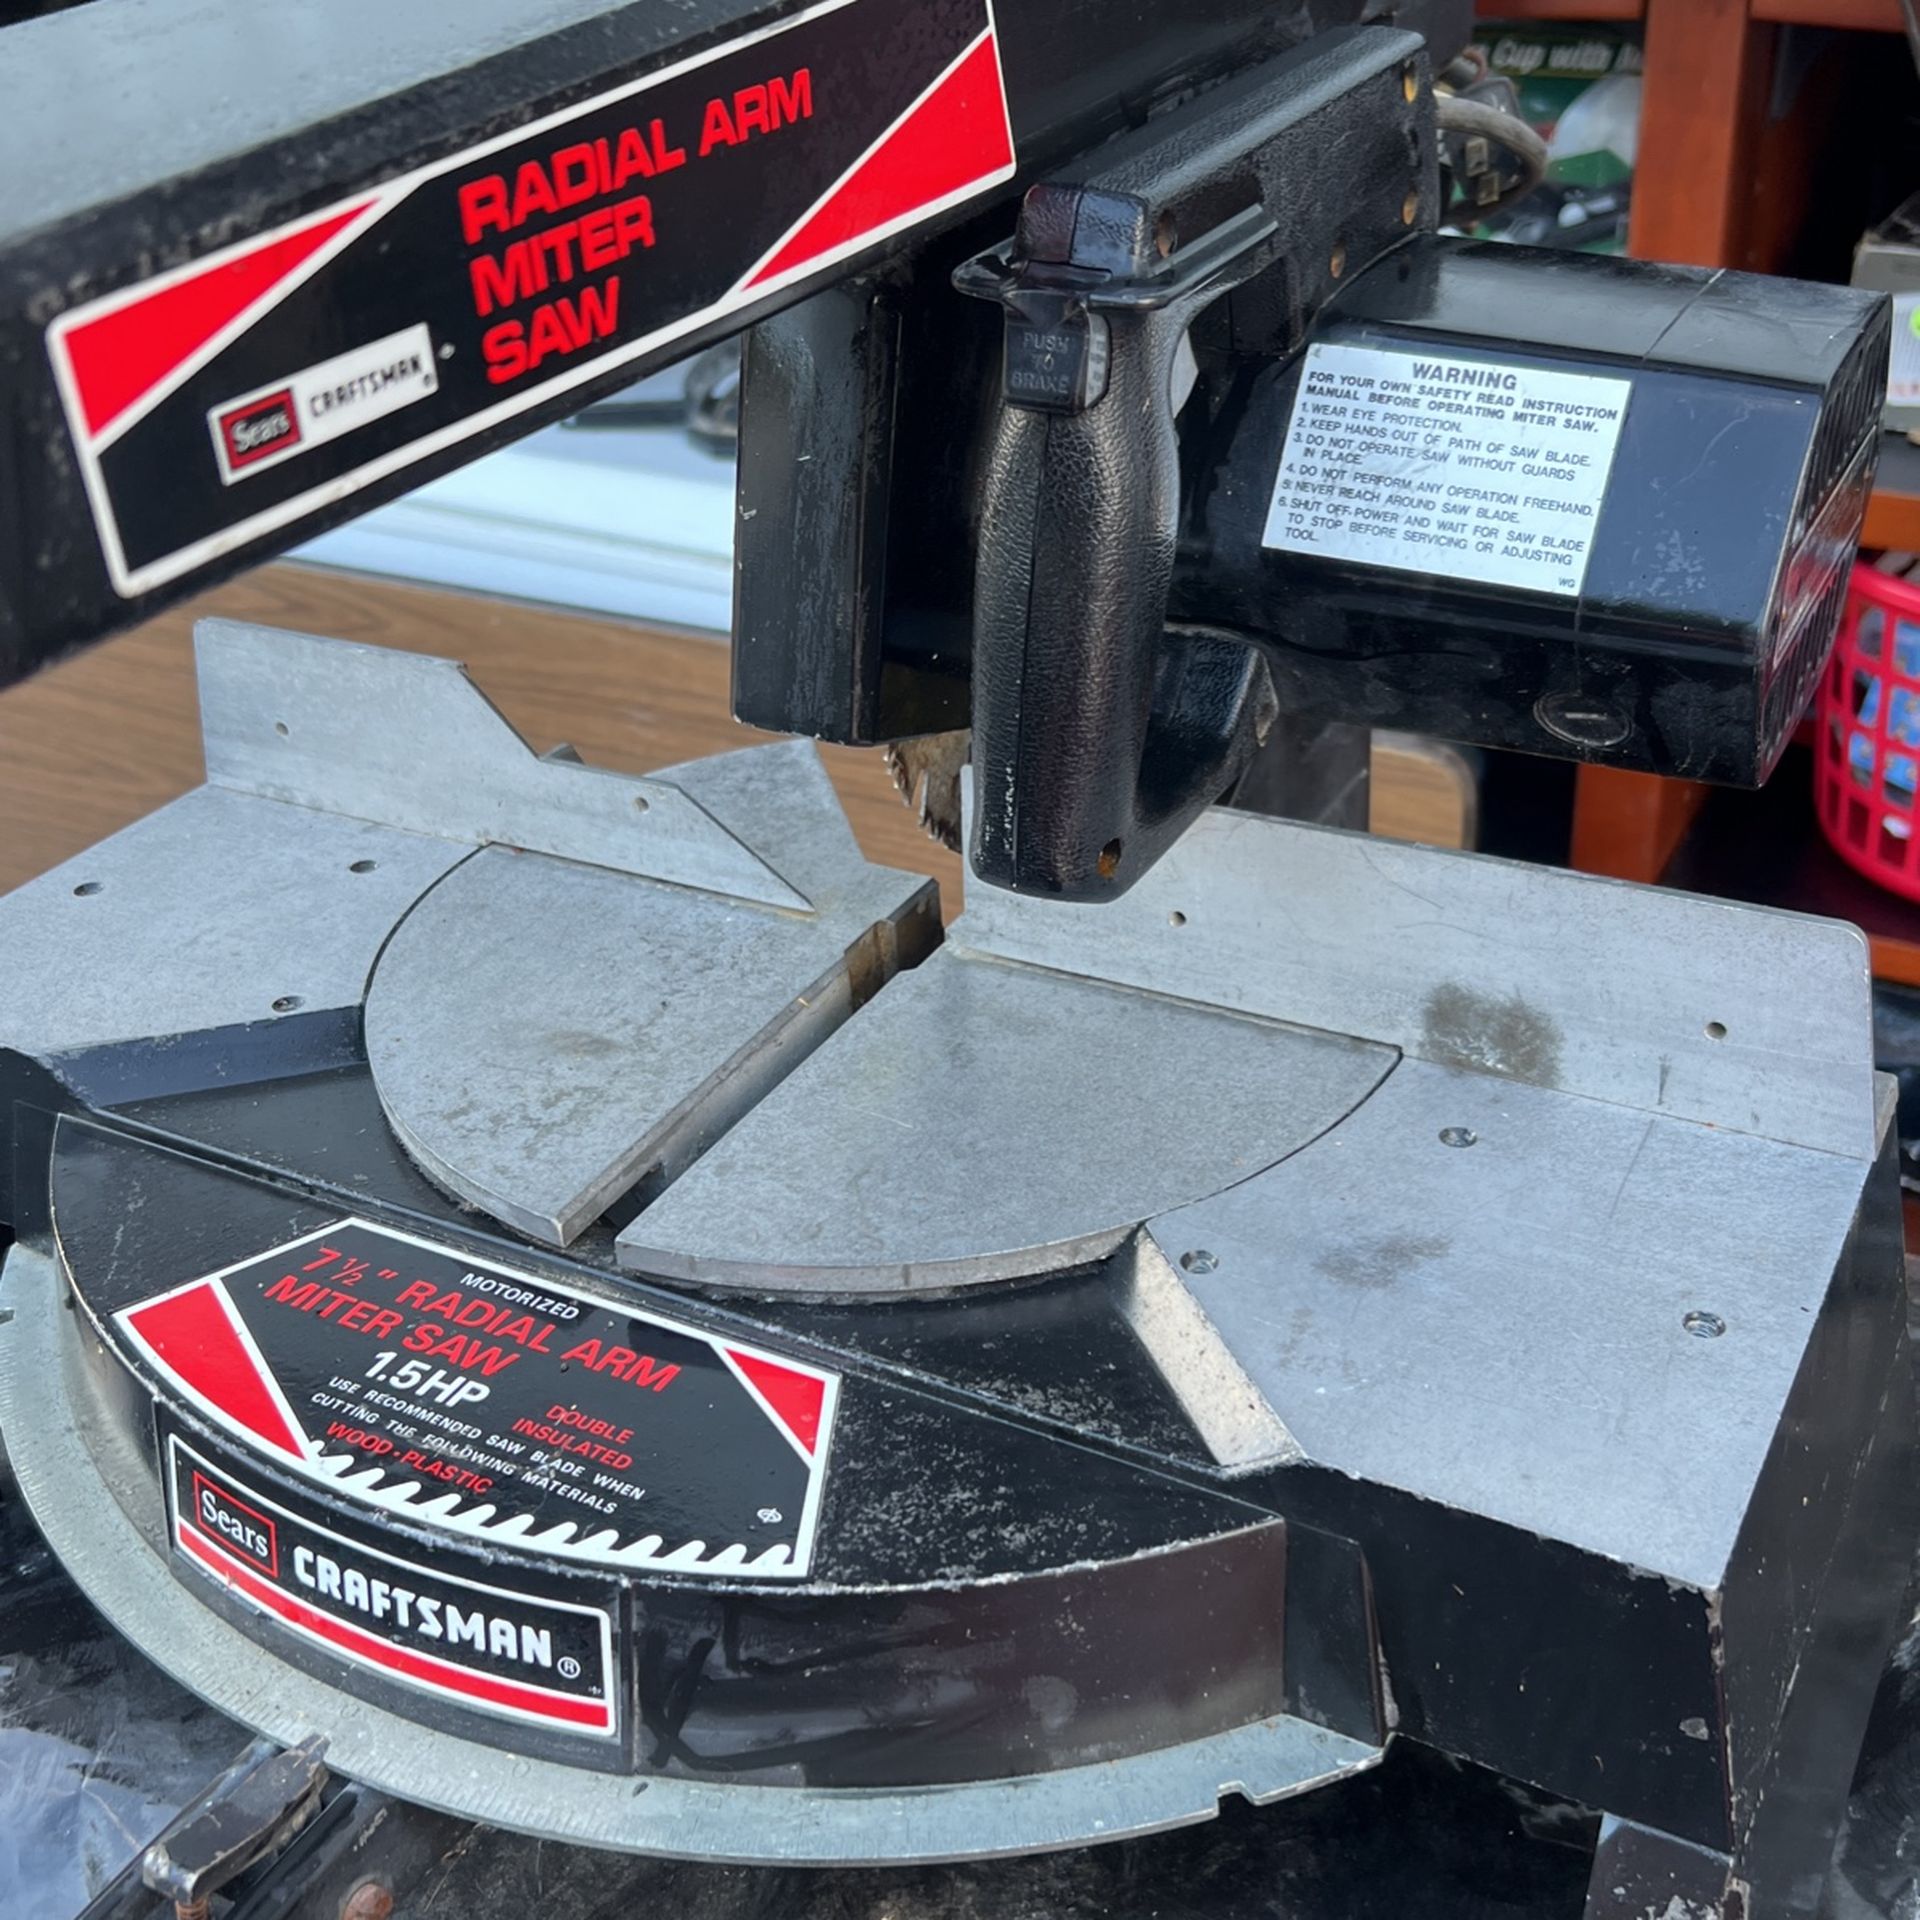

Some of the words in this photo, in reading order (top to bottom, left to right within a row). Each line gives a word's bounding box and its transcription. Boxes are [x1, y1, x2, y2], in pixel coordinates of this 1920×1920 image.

[458, 118, 686, 246] RADIAL
[698, 68, 812, 157] ARM
[470, 194, 656, 317] MITER
[482, 276, 620, 384] SAW
[1023, 331, 1070, 351] PUSH
[1010, 370, 1069, 395] BRAKE
[1308, 371, 1334, 384] FOR
[1340, 375, 1375, 389] YOUR
[1380, 380, 1412, 394] OWN
[1417, 385, 1472, 401] SAFETY
[1476, 392, 1515, 407] READ
[1522, 398, 1619, 421] INSTRUCTION
[1413, 362, 1517, 391] WARNING
[232, 410, 291, 454] Sears
[309, 353, 423, 419] CRAFTSMAN
[1306, 385, 1360, 401] MANUAL
[1368, 392, 1421, 409] BEFORE
[1427, 400, 1505, 420] OPERATING
[1513, 411, 1556, 427] MITER
[1563, 418, 1599, 433] SAW.
[1311, 403, 1348, 417] WEAR
[1352, 409, 1377, 421] EYE
[1303, 447, 1315, 459] IN
[1306, 434, 1325, 446] DO
[1329, 437, 1356, 449] NOT
[1358, 441, 1416, 459] OPERATE
[1421, 449, 1450, 463] SAW
[1457, 454, 1516, 473] WITHOUT
[1521, 463, 1576, 481] GUARDS
[1309, 418, 1342, 433] KEEP
[1345, 423, 1388, 439] HANDS
[1391, 430, 1418, 443] OUT
[1424, 433, 1442, 446] OF
[1448, 437, 1481, 452] PATH
[1487, 442, 1504, 454] OF
[1510, 445, 1540, 459] SAW
[1295, 479, 1336, 496] NEVER
[1338, 487, 1381, 502] REACH
[1386, 494, 1436, 511] AROUND
[1441, 502, 1471, 516] SAW
[1299, 464, 1318, 477] DO
[1322, 467, 1347, 481] NOT
[1353, 472, 1412, 490] PERFORM
[1417, 479, 1444, 494] ANY
[1447, 485, 1519, 506] OPERATION
[1523, 496, 1594, 517] FREEHAND.
[1288, 512, 1305, 525] TO
[1311, 516, 1343, 529] STOP
[1349, 522, 1397, 538] BEFORE
[1402, 530, 1468, 550] SERVICING
[1475, 541, 1494, 553] OR
[1500, 544, 1573, 566] ADJUSTING
[1290, 497, 1323, 512] SHUT
[1354, 507, 1400, 524] POWER
[1404, 515, 1431, 528] AND
[1436, 519, 1469, 534] WAIT
[1472, 525, 1499, 539] FOR
[1506, 530, 1536, 545] SAW
[1541, 536, 1585, 552] BLADE
[460, 1273, 580, 1320] MOTORIZED
[263, 1274, 404, 1339] MITER
[402, 1323, 521, 1377] SAW
[395, 1279, 556, 1353] RADIAL
[560, 1338, 682, 1392] ARM
[364, 1351, 491, 1408] 1.5HP
[328, 1376, 361, 1394] USE
[364, 1389, 482, 1439] RECOMMENDED
[486, 1434, 526, 1455] SAW
[530, 1450, 586, 1478] BLADE
[592, 1473, 646, 1500] WHEN
[512, 1418, 633, 1470] INSULATED
[546, 1404, 635, 1444] DOUBLE
[311, 1392, 380, 1424] CUTTING
[386, 1419, 418, 1438] THE
[422, 1433, 517, 1476] FOLLOWING
[521, 1471, 618, 1514] MATERIALS
[401, 1449, 493, 1494] PLASTIC
[201, 1489, 269, 1559] Sears
[293, 1545, 552, 1668] CRAFTSMAN
